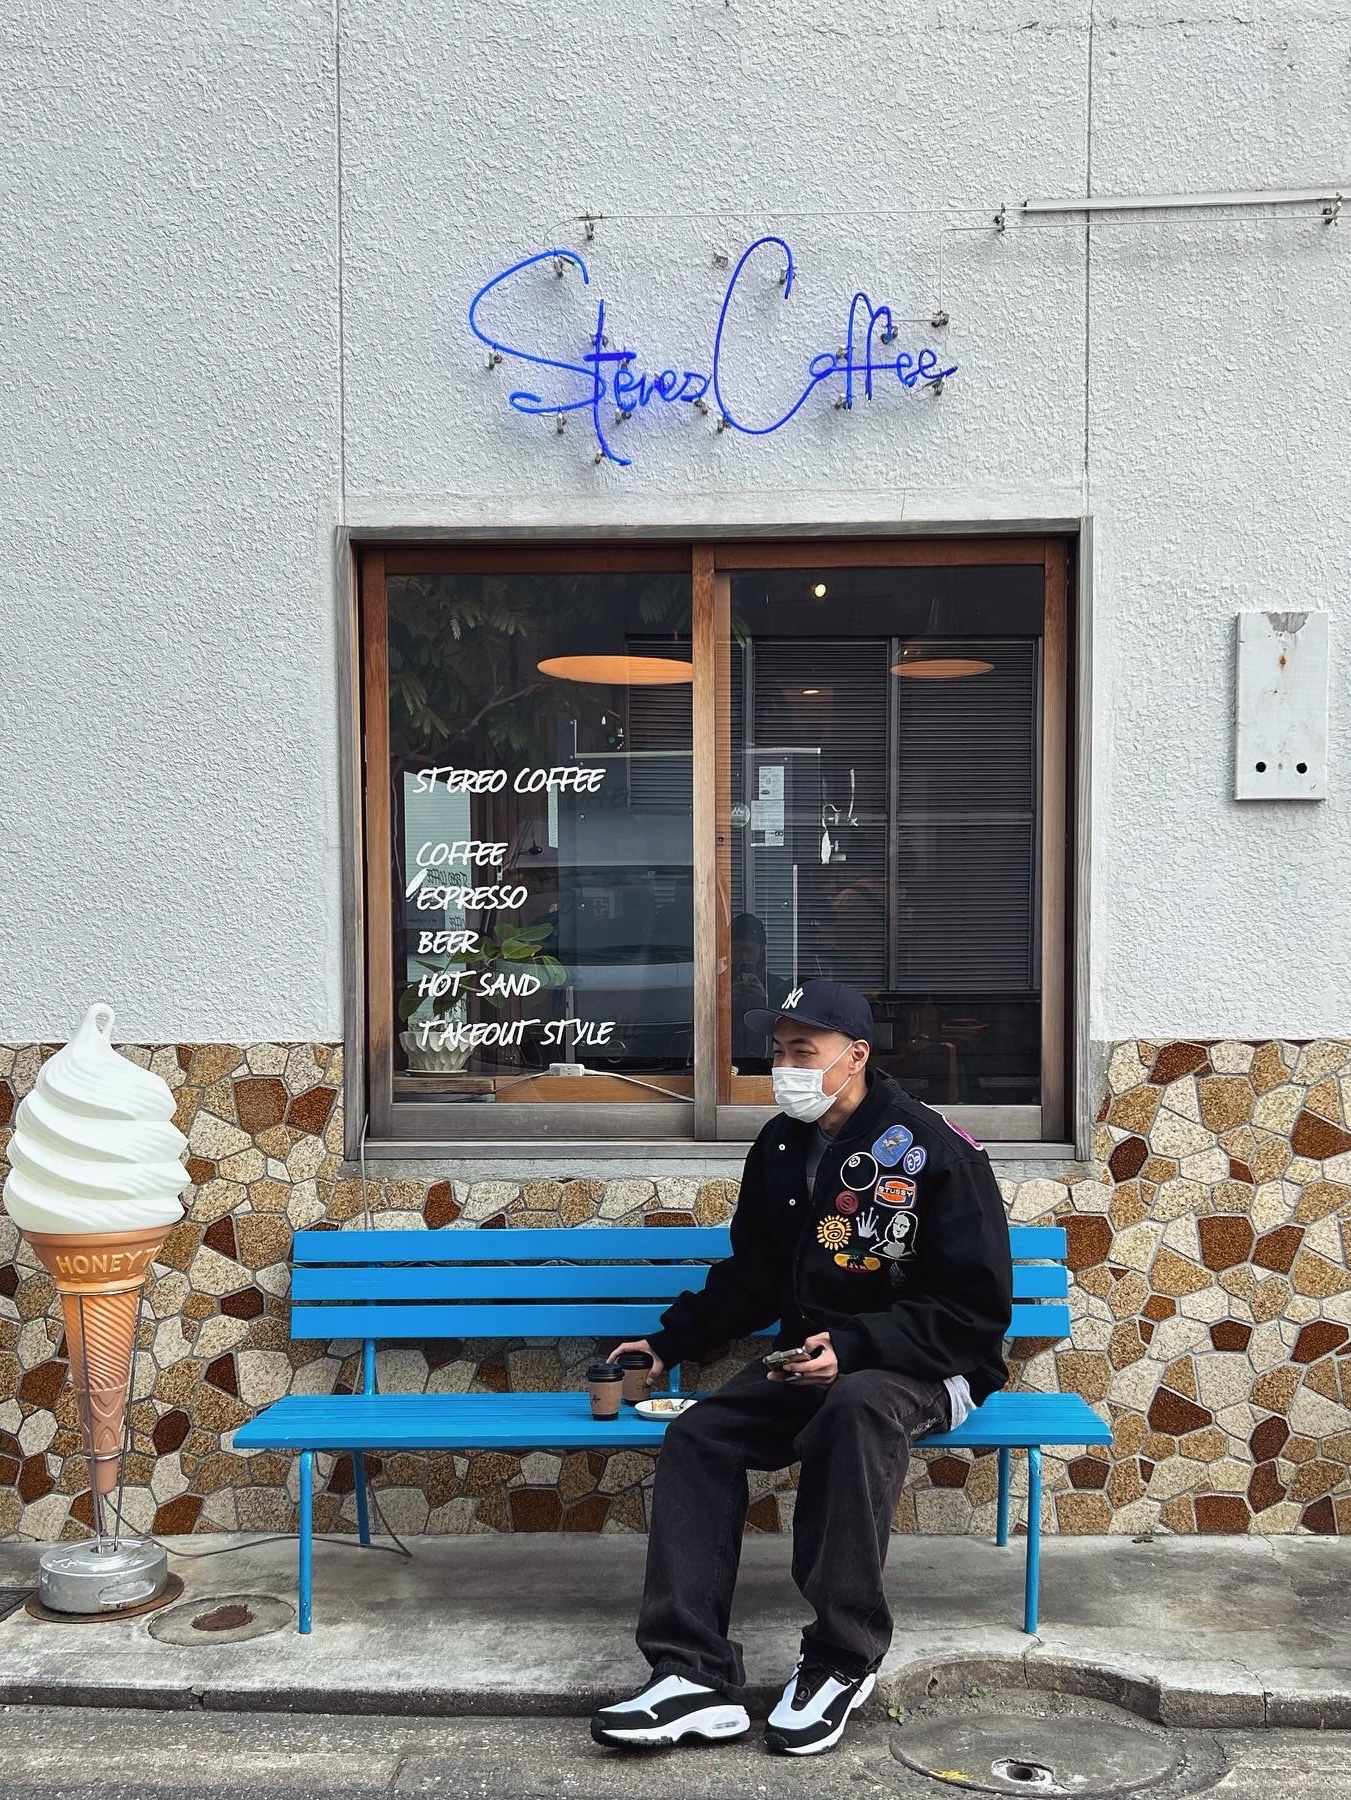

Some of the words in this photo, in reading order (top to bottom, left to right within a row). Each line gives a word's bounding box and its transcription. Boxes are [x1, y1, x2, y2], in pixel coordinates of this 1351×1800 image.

[469, 249, 709, 466] Stereo
[714, 236, 958, 435] Coffee
[413, 766, 507, 793] STEREO
[514, 766, 606, 793] COFFEE
[416, 840, 508, 867] COFFEE
[416, 885, 528, 911] ESPRESSO
[417, 930, 480, 954] BEER
[418, 969, 476, 998] HOT
[475, 973, 541, 999] SAND
[419, 1018, 541, 1047] TAKEOUT
[539, 1018, 616, 1047] STYLE
[56, 1250, 142, 1275] HONEY
